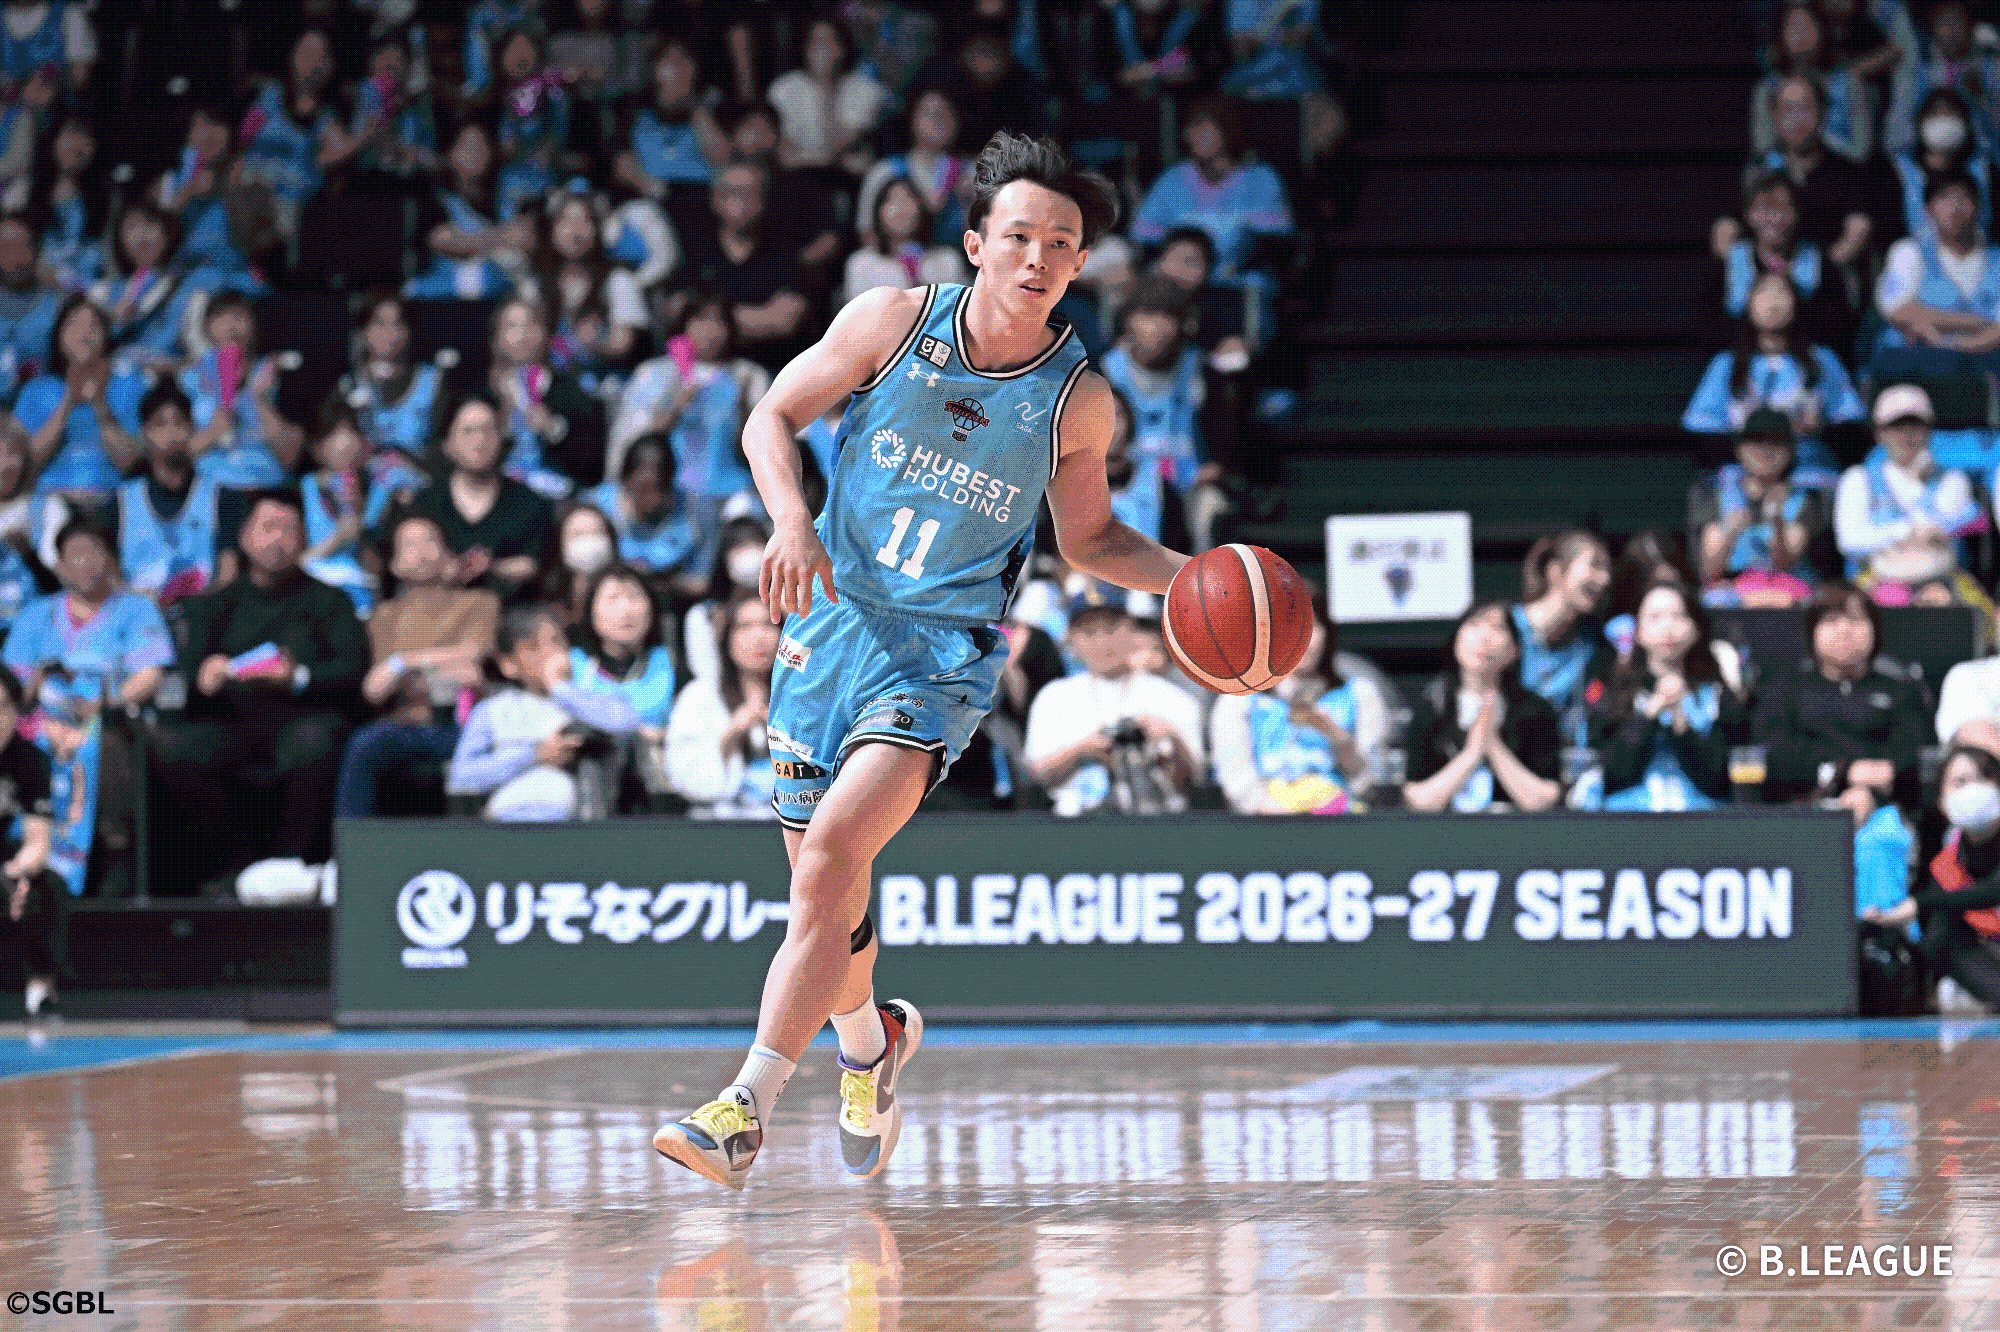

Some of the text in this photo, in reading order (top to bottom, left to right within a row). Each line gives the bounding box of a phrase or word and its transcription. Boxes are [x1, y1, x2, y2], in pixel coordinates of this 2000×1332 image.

[903, 465, 1011, 523] HOLDING
[910, 445, 1021, 506] HUBEST
[875, 506, 941, 581] 11
[486, 881, 791, 944] りそなグルー
[880, 867, 1792, 945] B.LEAGUE 2026-27 SEASON
